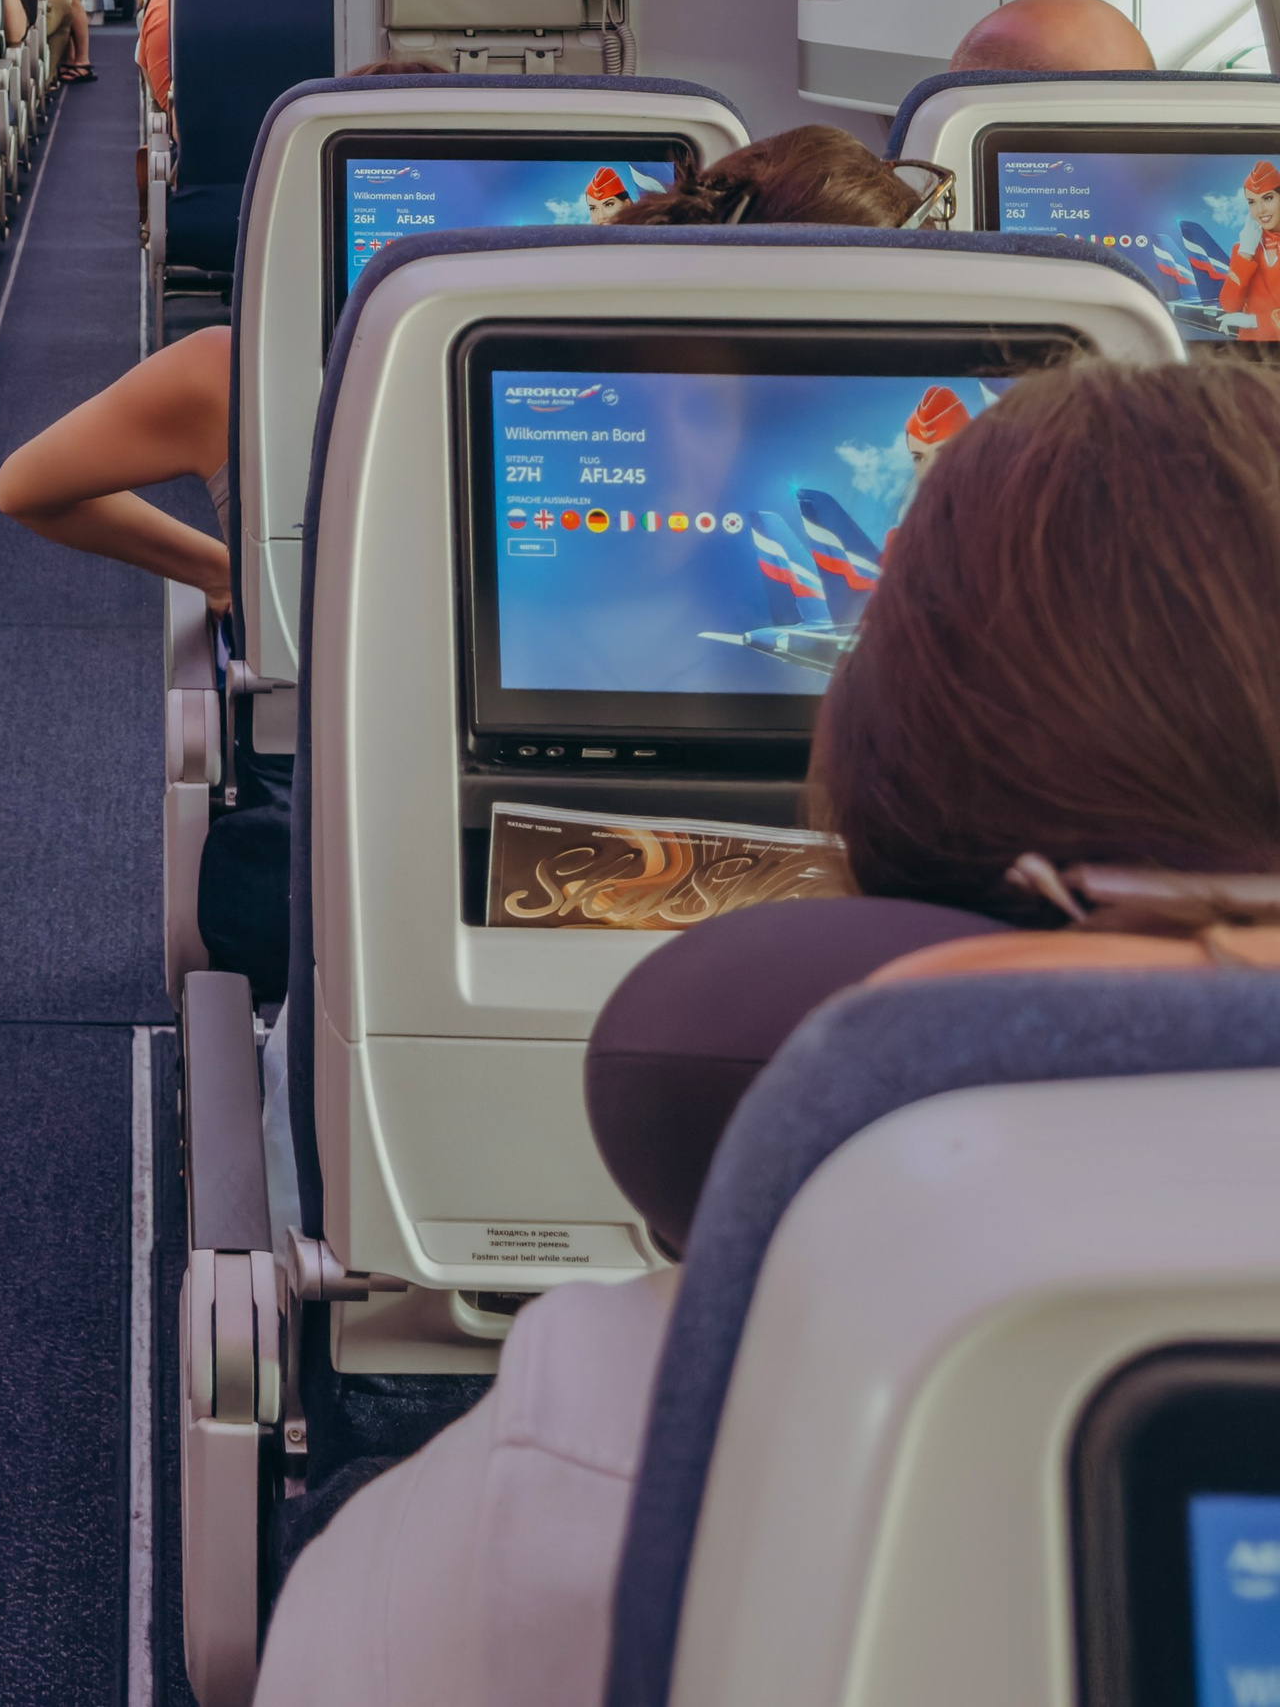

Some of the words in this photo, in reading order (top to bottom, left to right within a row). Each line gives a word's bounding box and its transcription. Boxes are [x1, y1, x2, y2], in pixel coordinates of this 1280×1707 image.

[1004, 185, 1056, 194] Wilkommen
[1069, 186, 1090, 194] Bord
[353, 191, 402, 200] Wilkommen
[415, 191, 436, 201] Bord
[353, 214, 375, 224] 26H
[1005, 209, 1026, 219] 26J
[1050, 209, 1090, 219] AFL245
[396, 215, 436, 225] AFL245
[504, 387, 580, 398] AEROFLOT
[504, 426, 588, 442] Wilkommen
[591, 430, 609, 442] an
[612, 427, 646, 443] Bord
[505, 455, 544, 464] SITZPLATZ
[579, 456, 601, 465] FLUG
[506, 466, 542, 482] 27H
[579, 467, 647, 484] AFL245
[506, 495, 542, 504] SPRACHE
[543, 495, 591, 505] AUSWÄHLEN
[506, 820, 534, 831] КАТАЛОГ
[535, 824, 562, 833] ТОВАРОВ
[486, 1227, 529, 1238] Находясь
[489, 1240, 536, 1248] застегните
[537, 1241, 570, 1249] ремень
[471, 1252, 499, 1261] Fasten
[501, 1254, 519, 1262] seat
[520, 1254, 536, 1262] belt
[538, 1255, 560, 1263] while
[561, 1255, 590, 1263] seated
